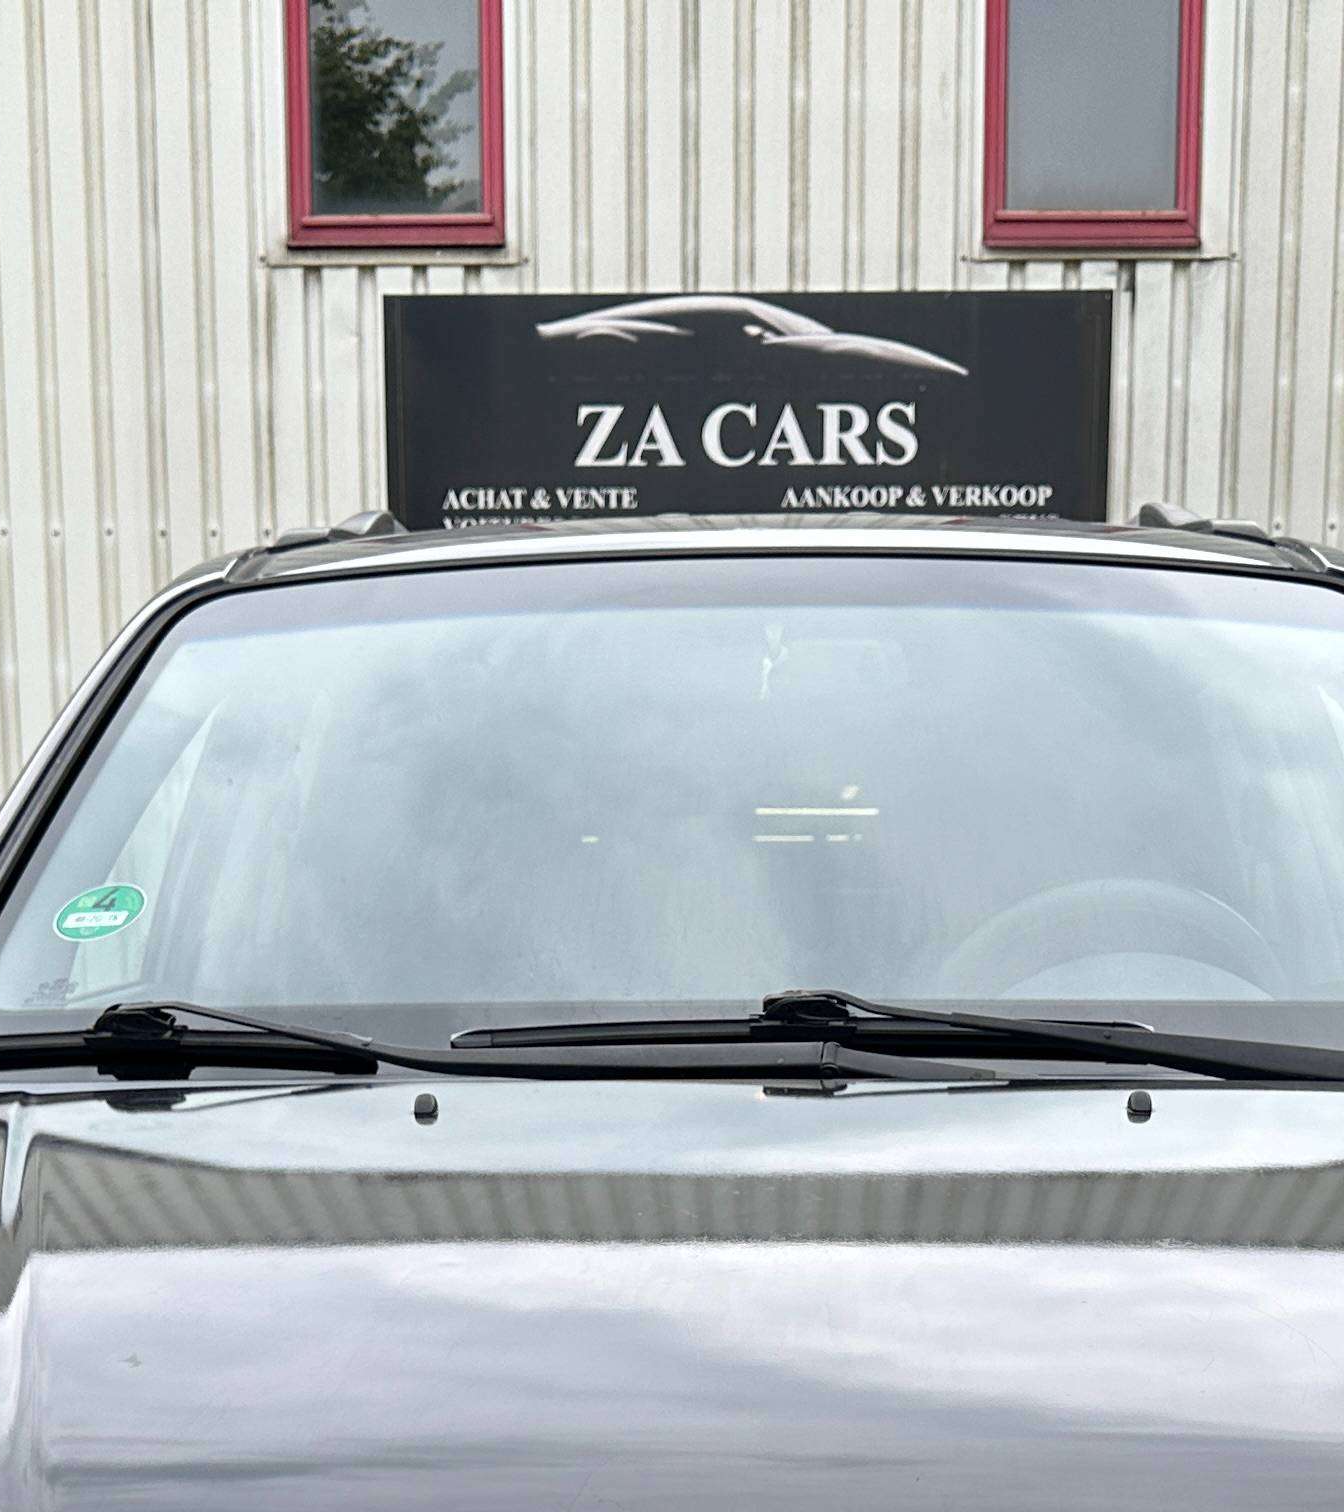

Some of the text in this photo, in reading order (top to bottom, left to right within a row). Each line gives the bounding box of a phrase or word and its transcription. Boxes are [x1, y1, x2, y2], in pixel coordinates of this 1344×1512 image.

[574, 401, 919, 467] ZA CARS
[442, 486, 639, 510] ACHAT & VENTE
[780, 484, 1054, 509] AANKOOP & VERKOOP
